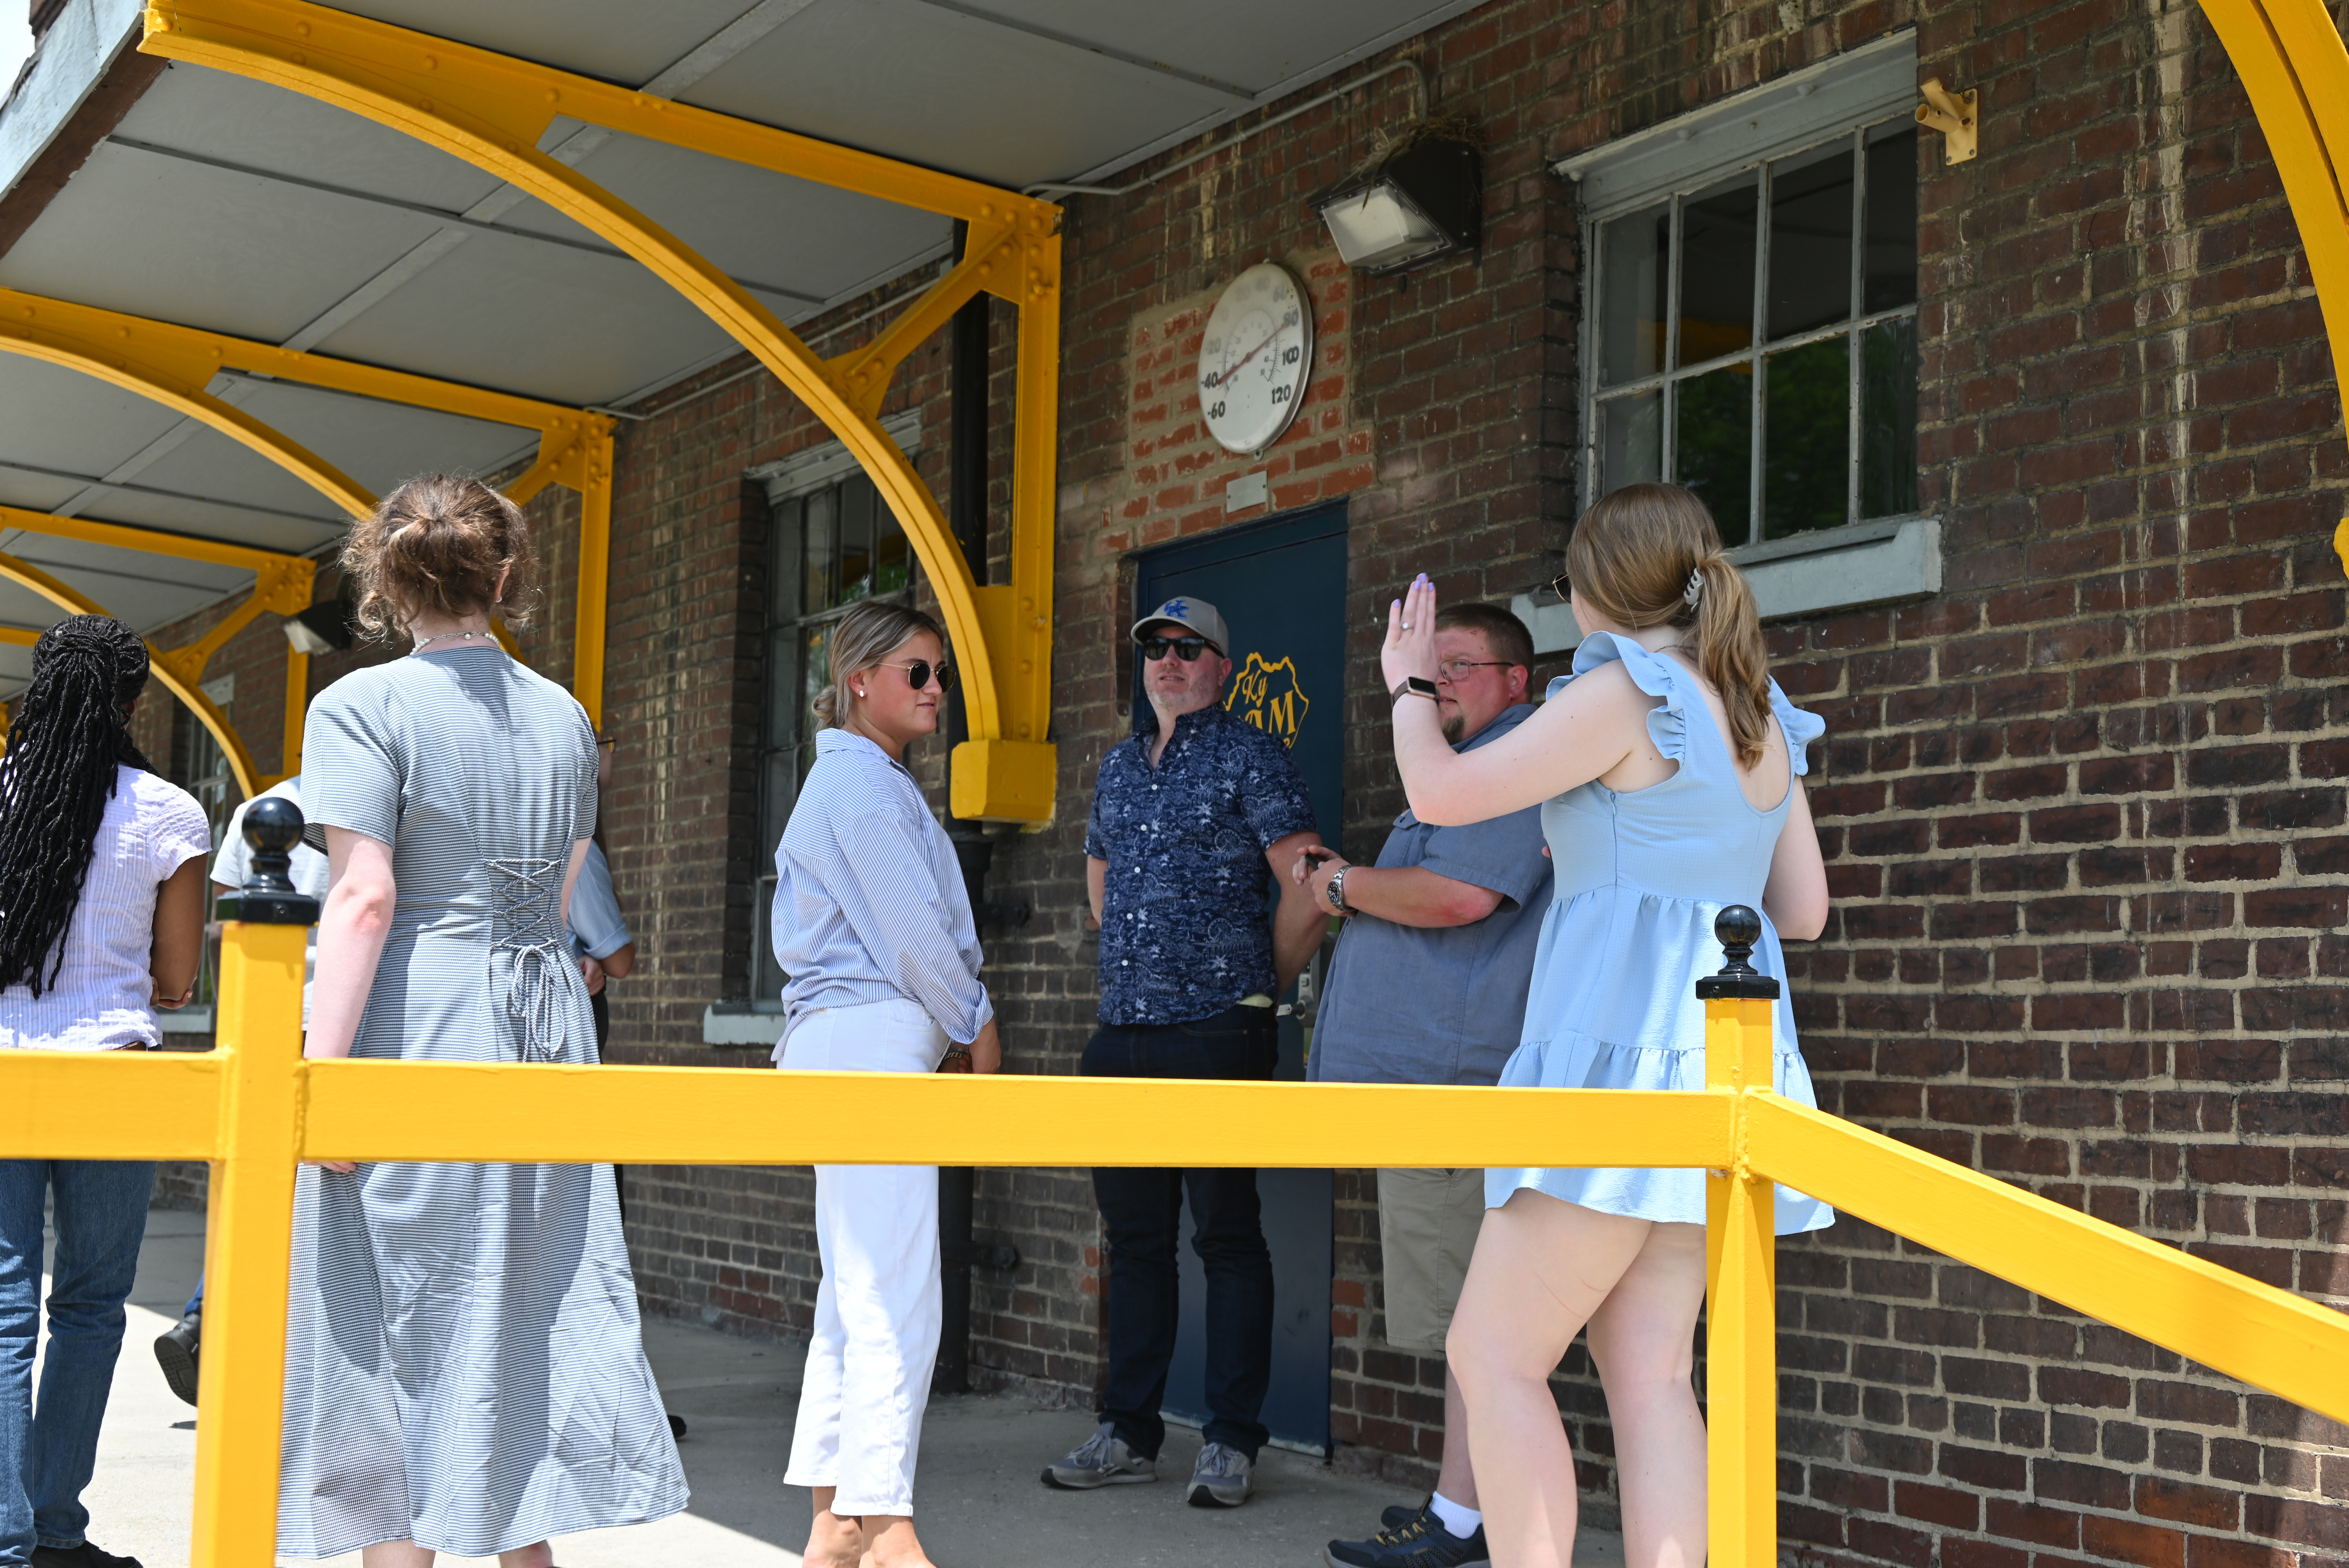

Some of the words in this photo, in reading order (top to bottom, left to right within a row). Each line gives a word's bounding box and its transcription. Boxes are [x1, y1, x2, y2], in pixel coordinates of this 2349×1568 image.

[1282, 346, 1300, 365] 100
[1201, 372, 1219, 389] -40
[1271, 384, 1291, 404] 120
[1207, 401, 1226, 420] -60
[1242, 669, 1269, 708] Ky
